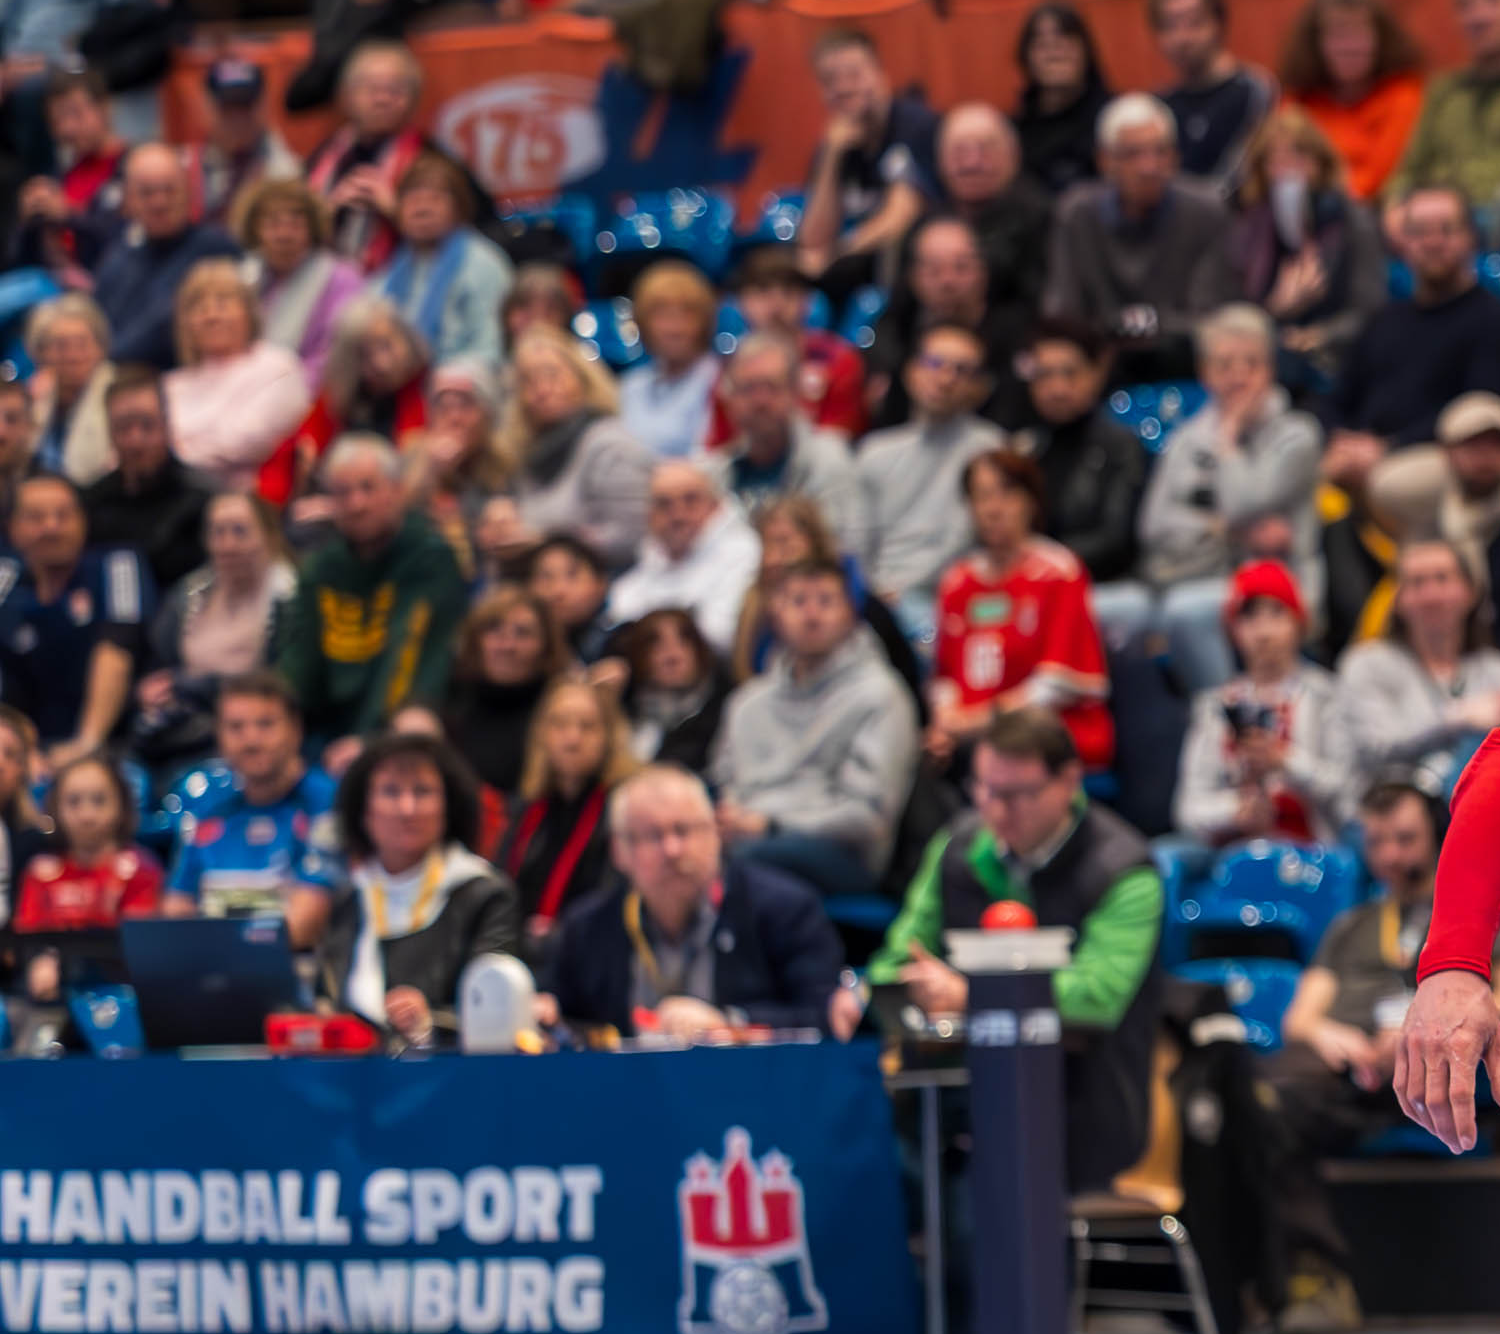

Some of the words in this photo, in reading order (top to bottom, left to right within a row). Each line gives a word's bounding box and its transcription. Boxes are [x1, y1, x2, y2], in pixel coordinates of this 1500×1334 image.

[3, 1169, 349, 1245] HANDBALL
[365, 1165, 604, 1243] SPORT
[0, 1259, 252, 1334] VEREIN
[261, 1257, 606, 1334] HAMBURG
